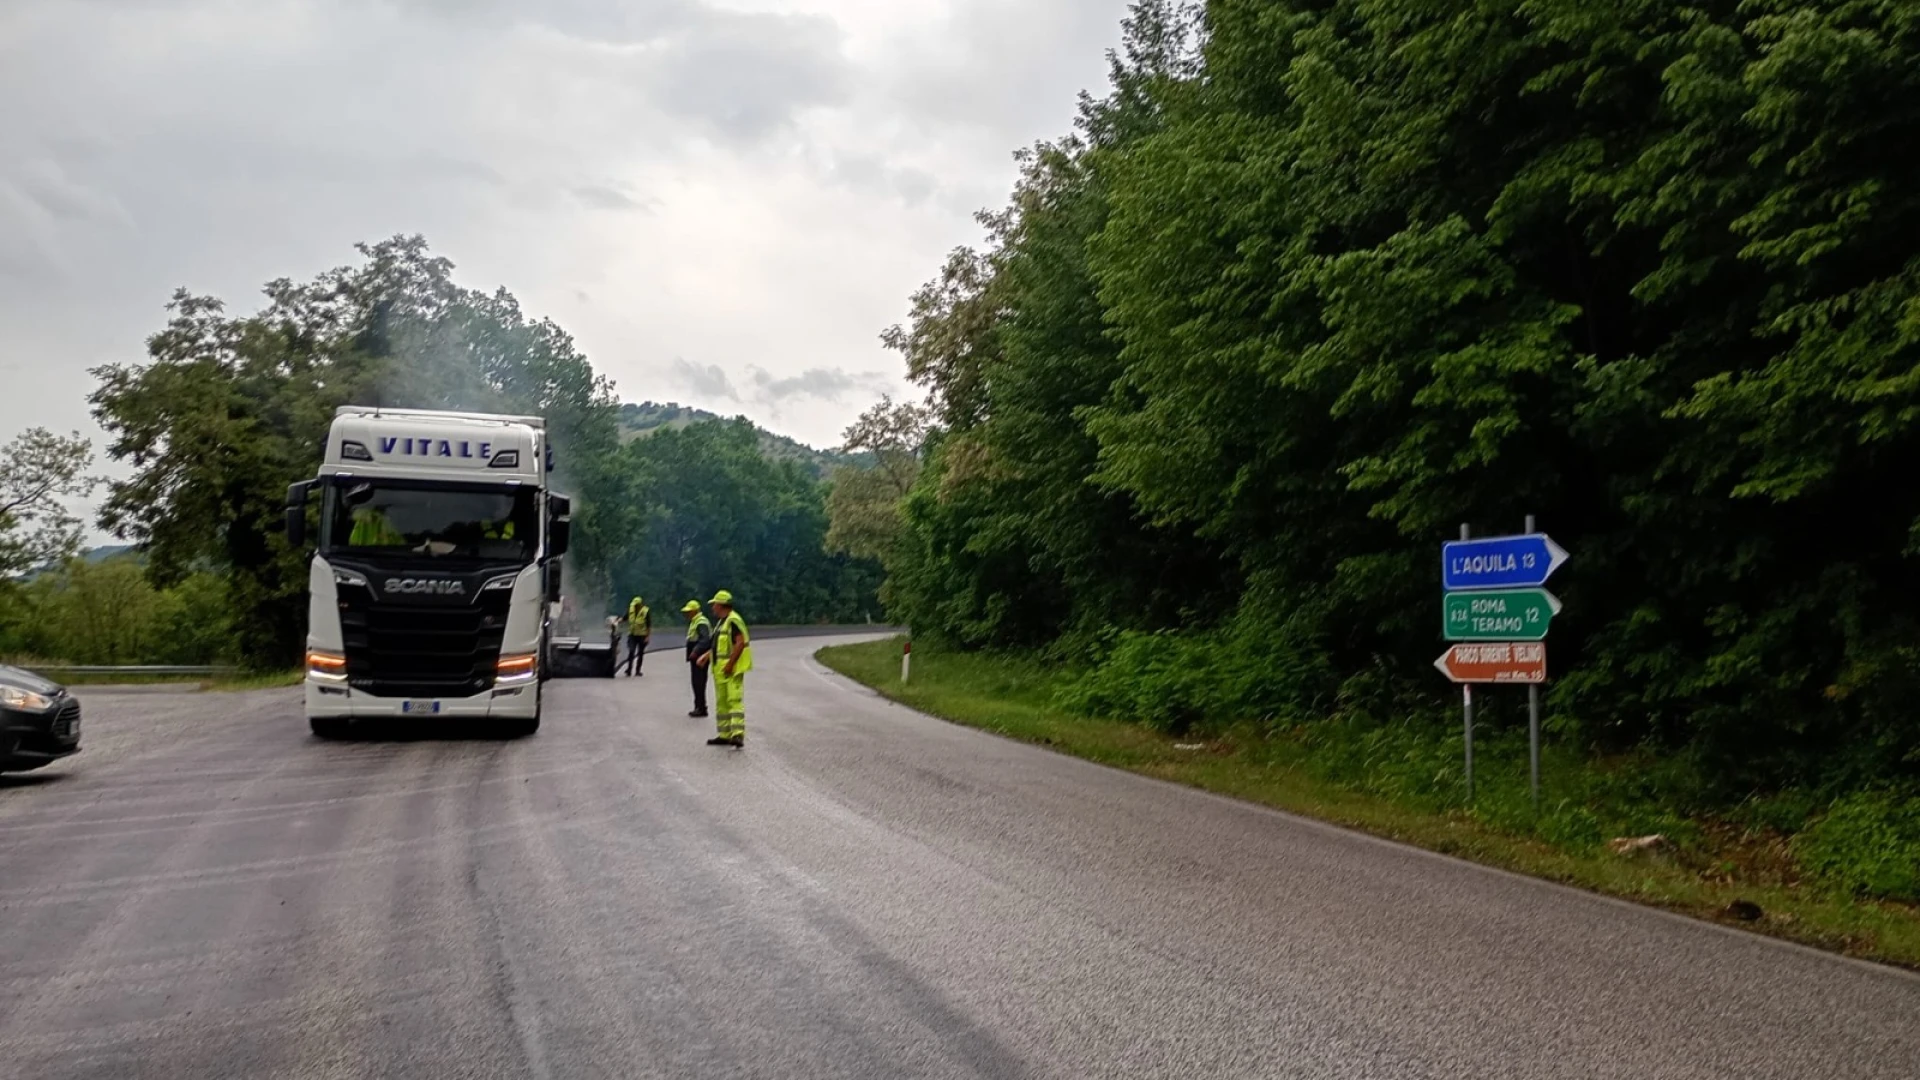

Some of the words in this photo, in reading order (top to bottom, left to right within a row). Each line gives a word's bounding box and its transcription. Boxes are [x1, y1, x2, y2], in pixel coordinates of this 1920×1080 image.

[378, 437, 491, 458] VITALE
[1452, 554, 1517, 575] L'AQUILA
[1522, 553, 1535, 569] 13
[384, 578, 466, 594] SCANIA
[1471, 599, 1507, 613] ROMA
[1525, 607, 1539, 623] 12
[1471, 617, 1523, 632] TERAMO
